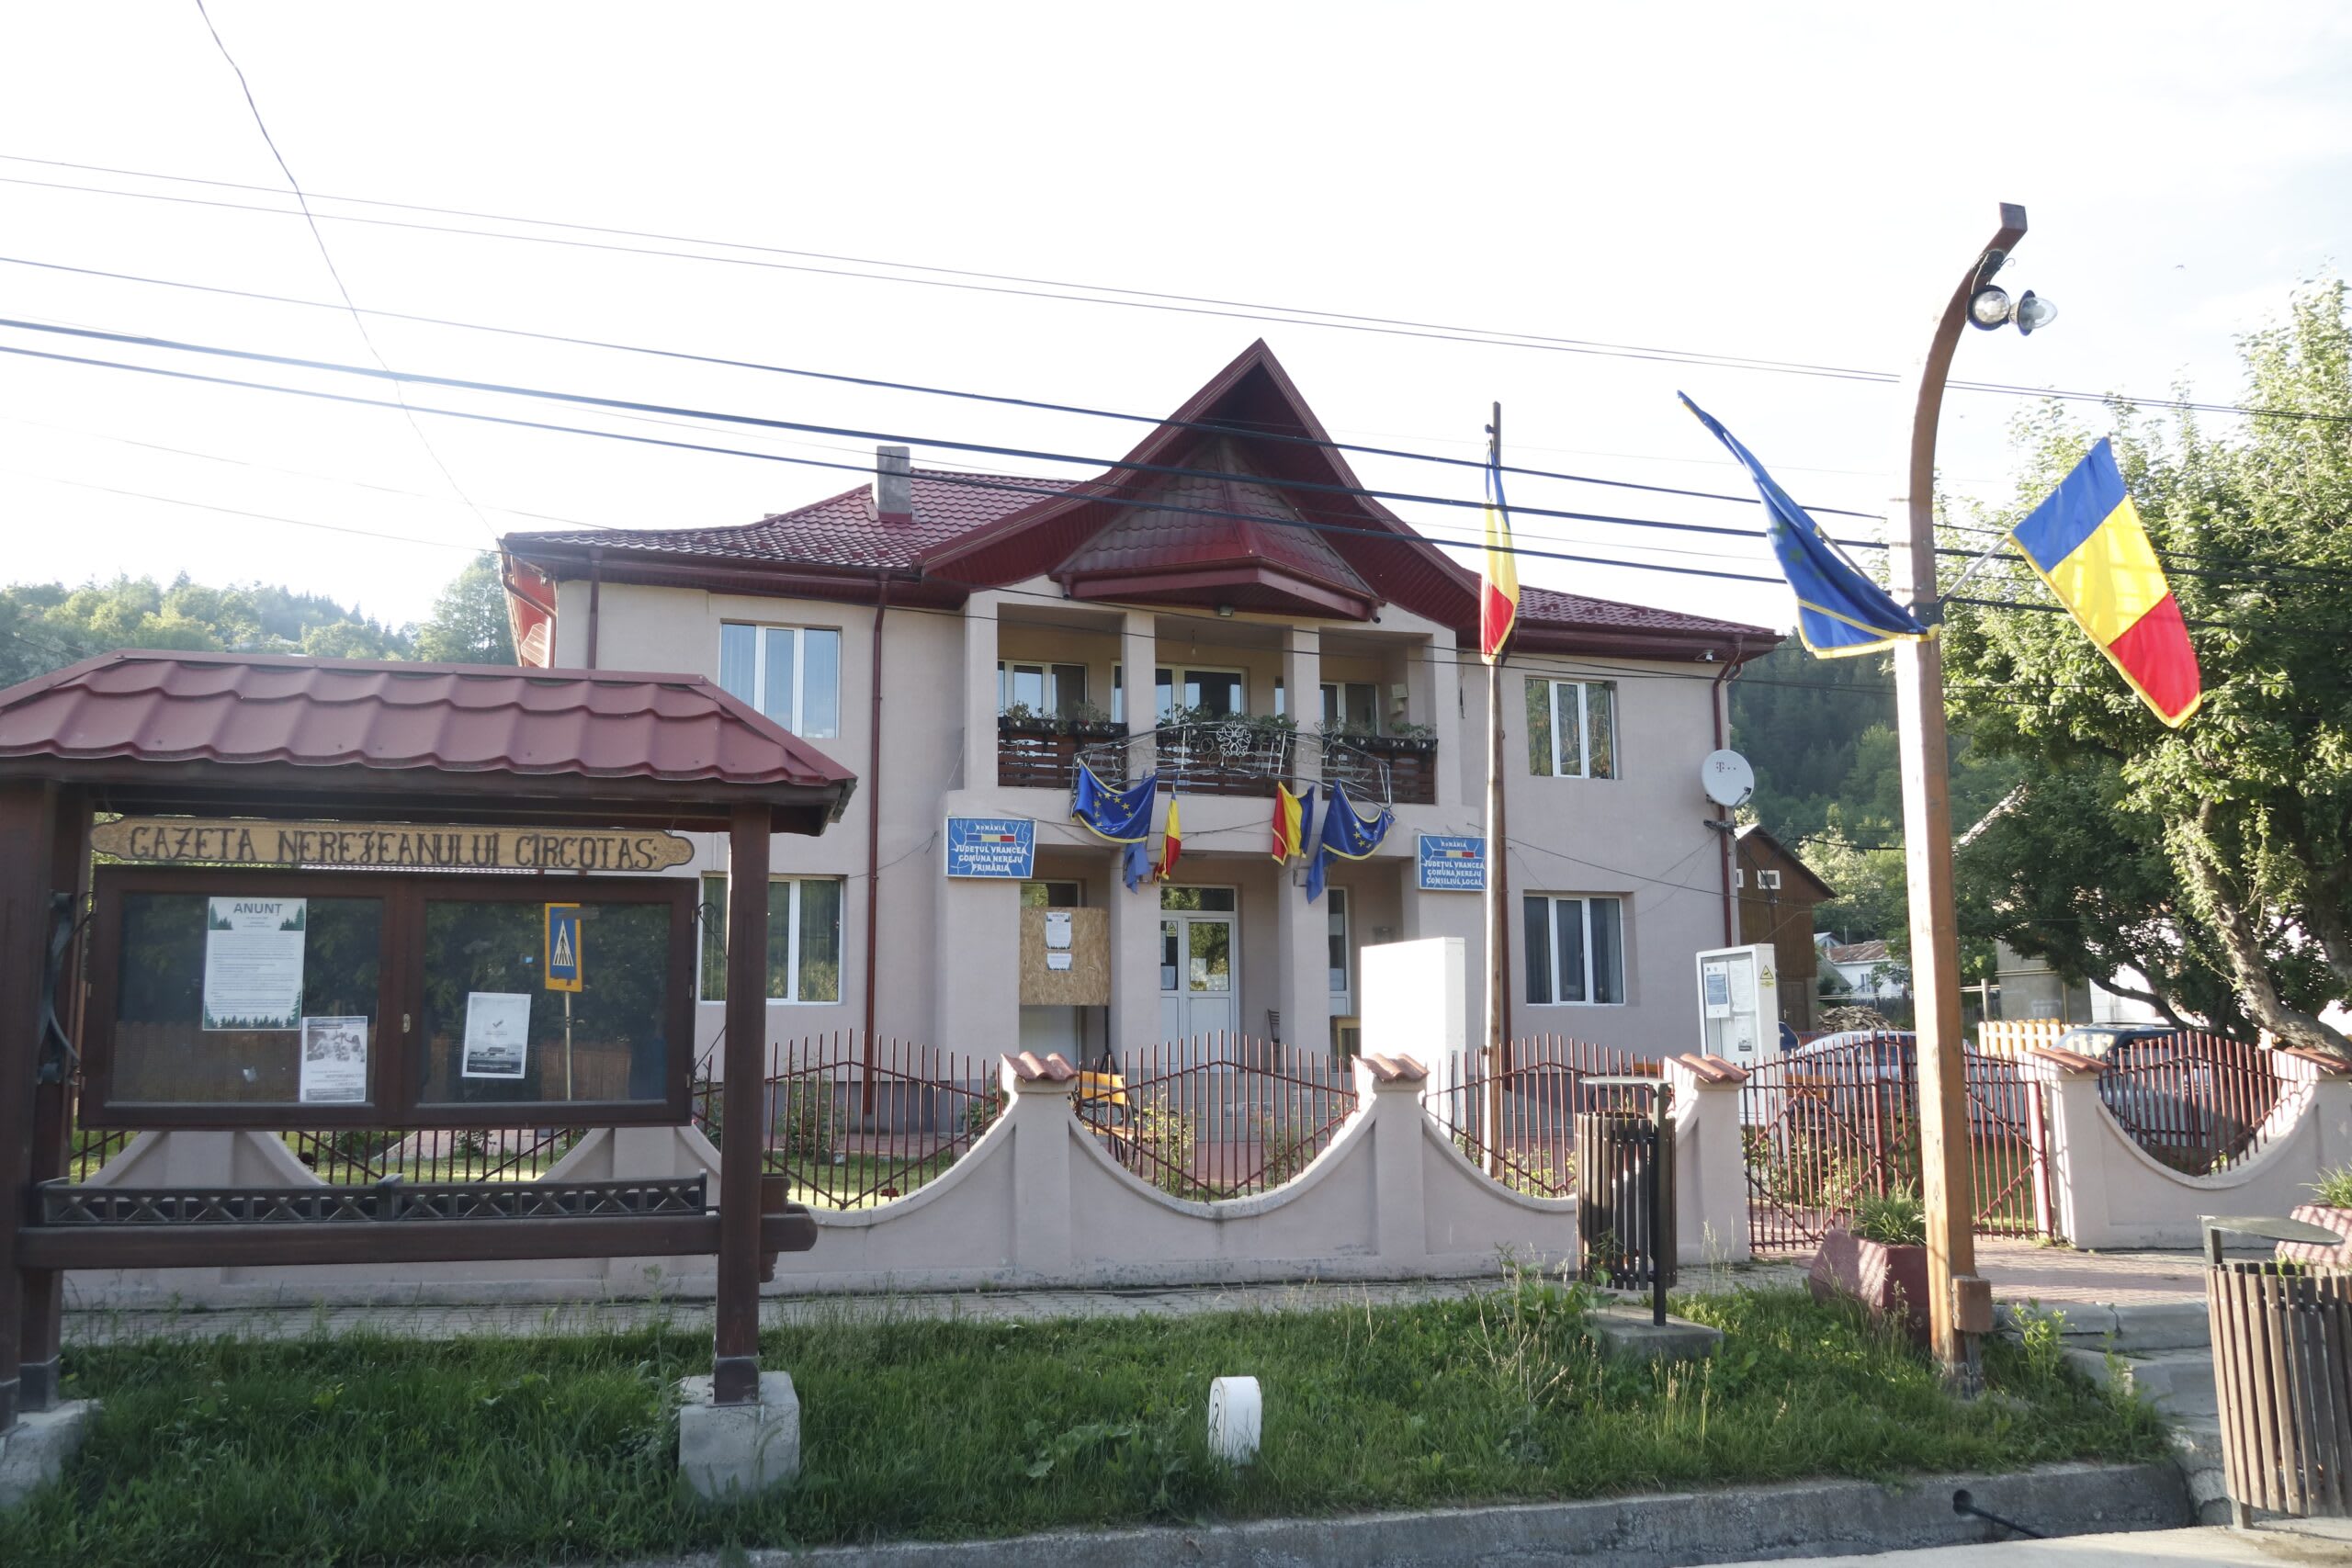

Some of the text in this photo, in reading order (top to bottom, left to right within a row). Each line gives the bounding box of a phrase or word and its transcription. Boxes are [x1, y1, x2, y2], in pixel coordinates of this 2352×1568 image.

[130, 826, 257, 862] GAZETA
[277, 829, 501, 868] NEREJEANULUI
[991, 846, 1026, 854] VRANCEA
[958, 854, 1023, 863] COMUNA NEREJU
[1454, 861, 1485, 870] VRANCEA
[1427, 869, 1482, 877] COMUNA NEREJU
[1426, 876, 1461, 885] CONSILIUL
